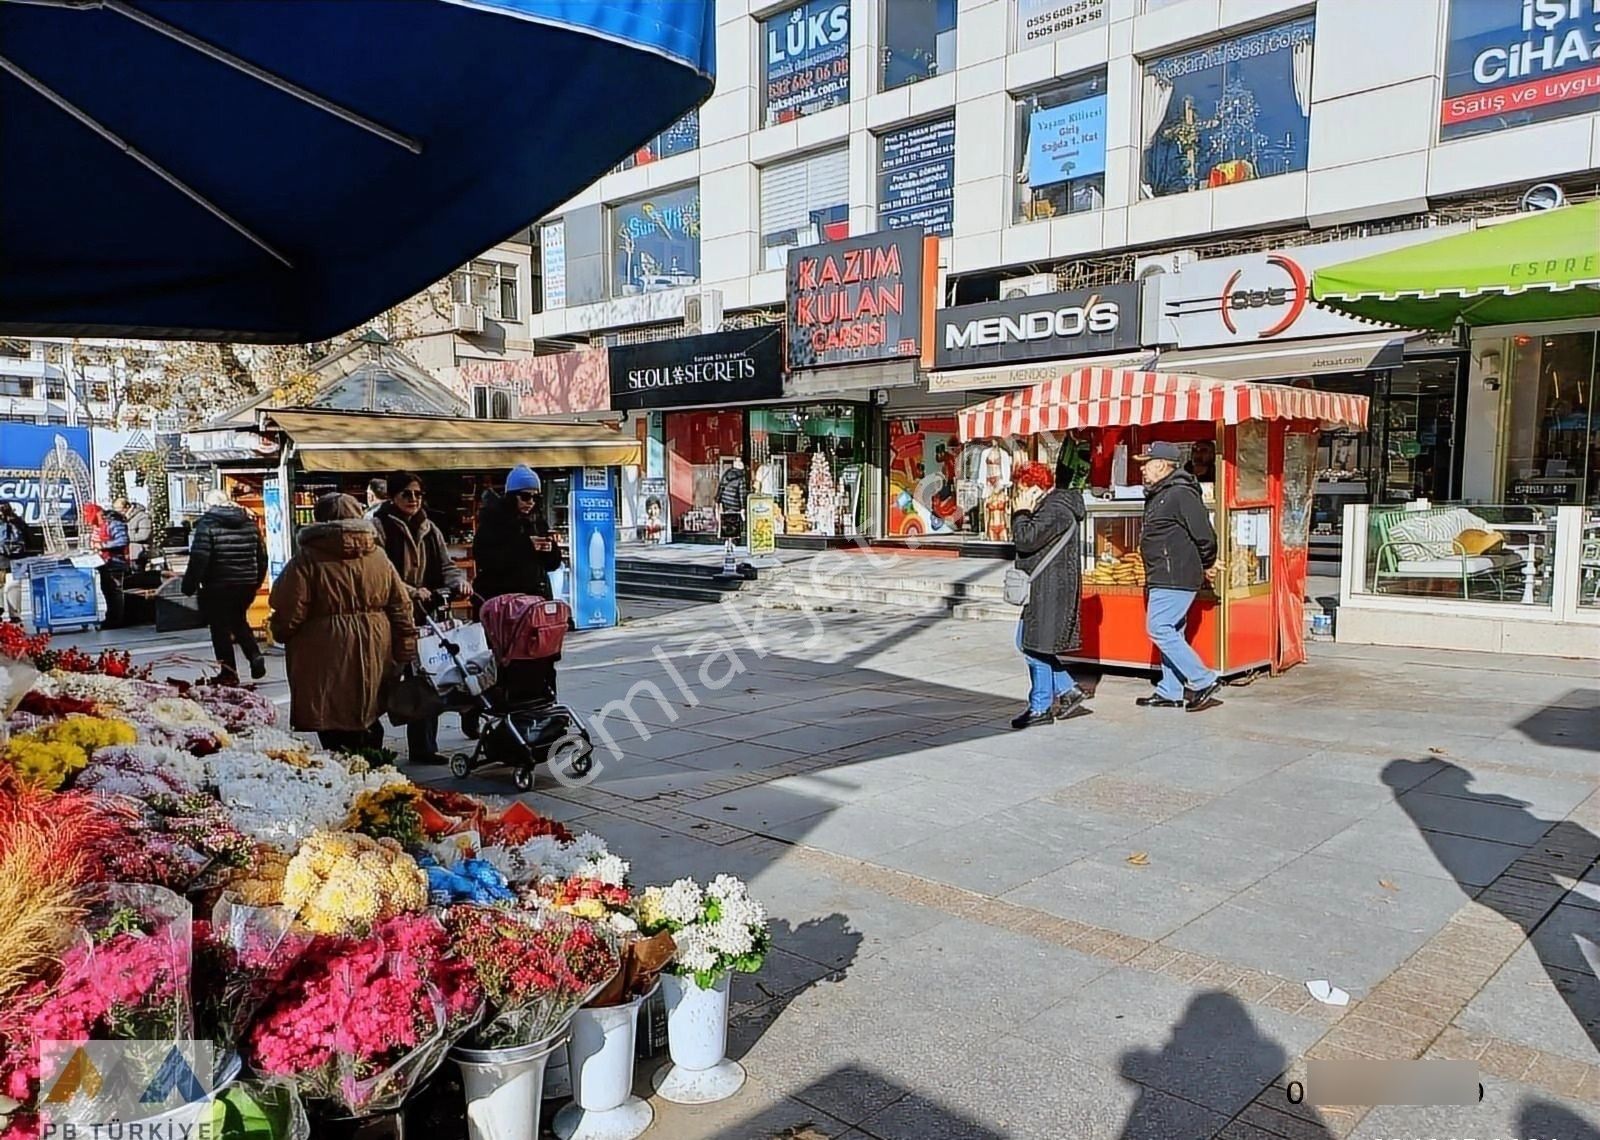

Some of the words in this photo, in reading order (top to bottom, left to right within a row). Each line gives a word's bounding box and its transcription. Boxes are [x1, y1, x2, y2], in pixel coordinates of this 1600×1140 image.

[1026, 12, 1052, 28] 0555
[1075, 1, 1088, 12] 25
[1027, 25, 1053, 40] 0505
[1075, 14, 1087, 25] 12
[1088, 9, 1102, 21] 58
[768, 4, 849, 64] LÜKS
[1450, 95, 1505, 116] Satış
[1512, 88, 1538, 103] ve
[798, 243, 903, 291] KAZIM
[797, 283, 904, 327] KULAN
[944, 294, 1120, 349] MENDO'S
[629, 367, 673, 389] SEOUL
[685, 357, 755, 383] SECRETS
